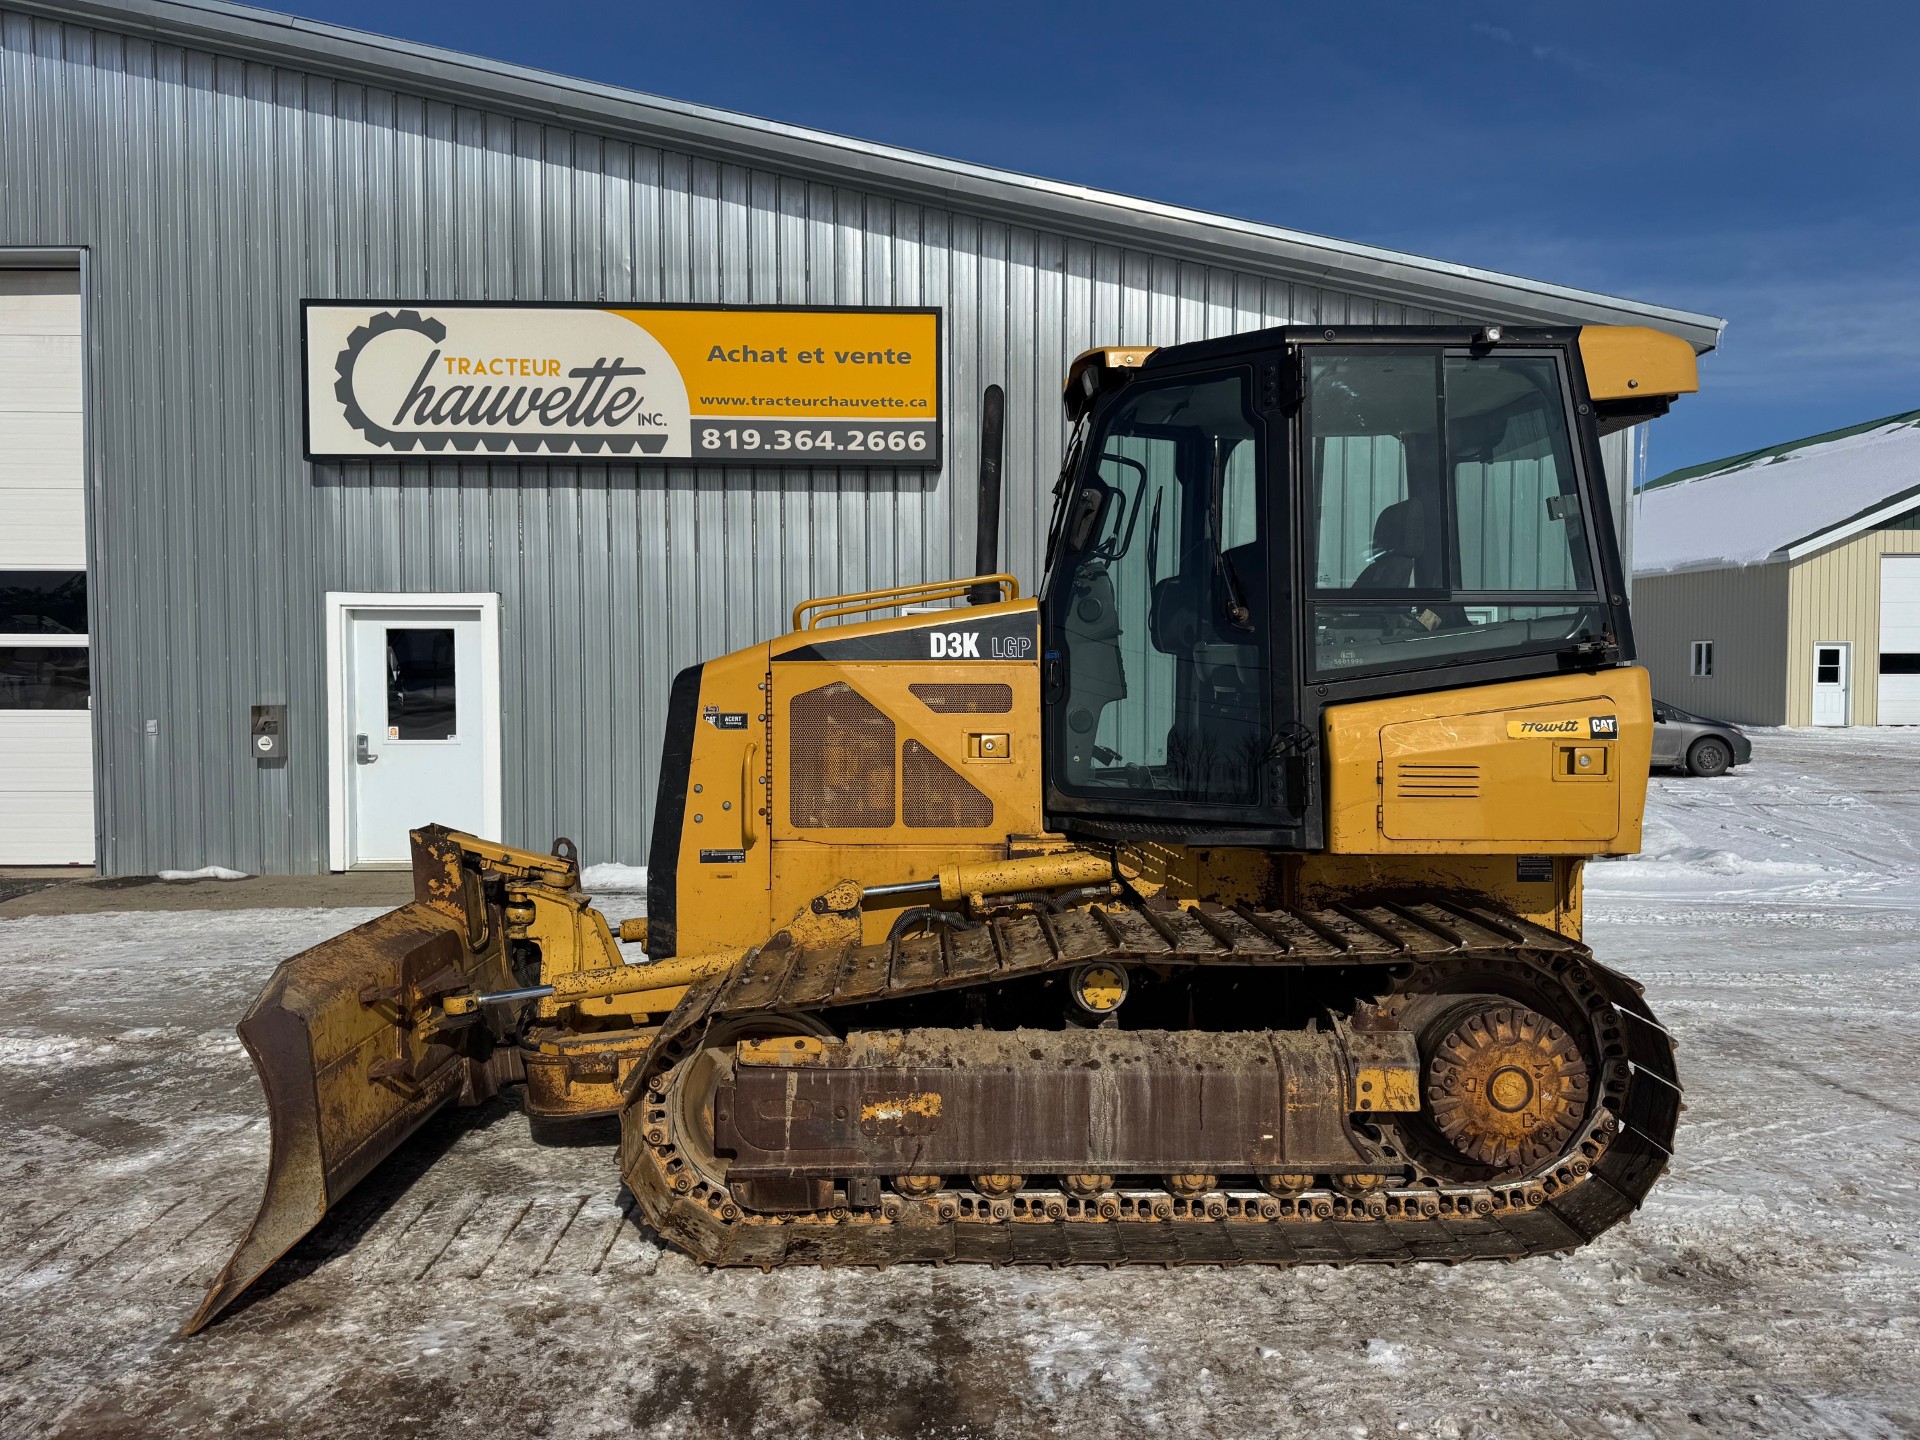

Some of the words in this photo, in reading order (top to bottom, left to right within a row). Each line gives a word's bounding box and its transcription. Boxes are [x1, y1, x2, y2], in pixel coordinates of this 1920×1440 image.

[707, 345, 788, 364] Achat
[797, 347, 825, 364] et
[834, 348, 912, 365] vente
[444, 357, 561, 377] TRACTEUR
[333, 309, 648, 449] Chauvette
[699, 395, 928, 408] www.tracteurchauvette.ca
[637, 412, 667, 427] INC.
[701, 428, 927, 451] 819.364.2666
[930, 632, 981, 658] D3K
[991, 636, 1032, 658] LGP
[1592, 718, 1616, 733] CAT
